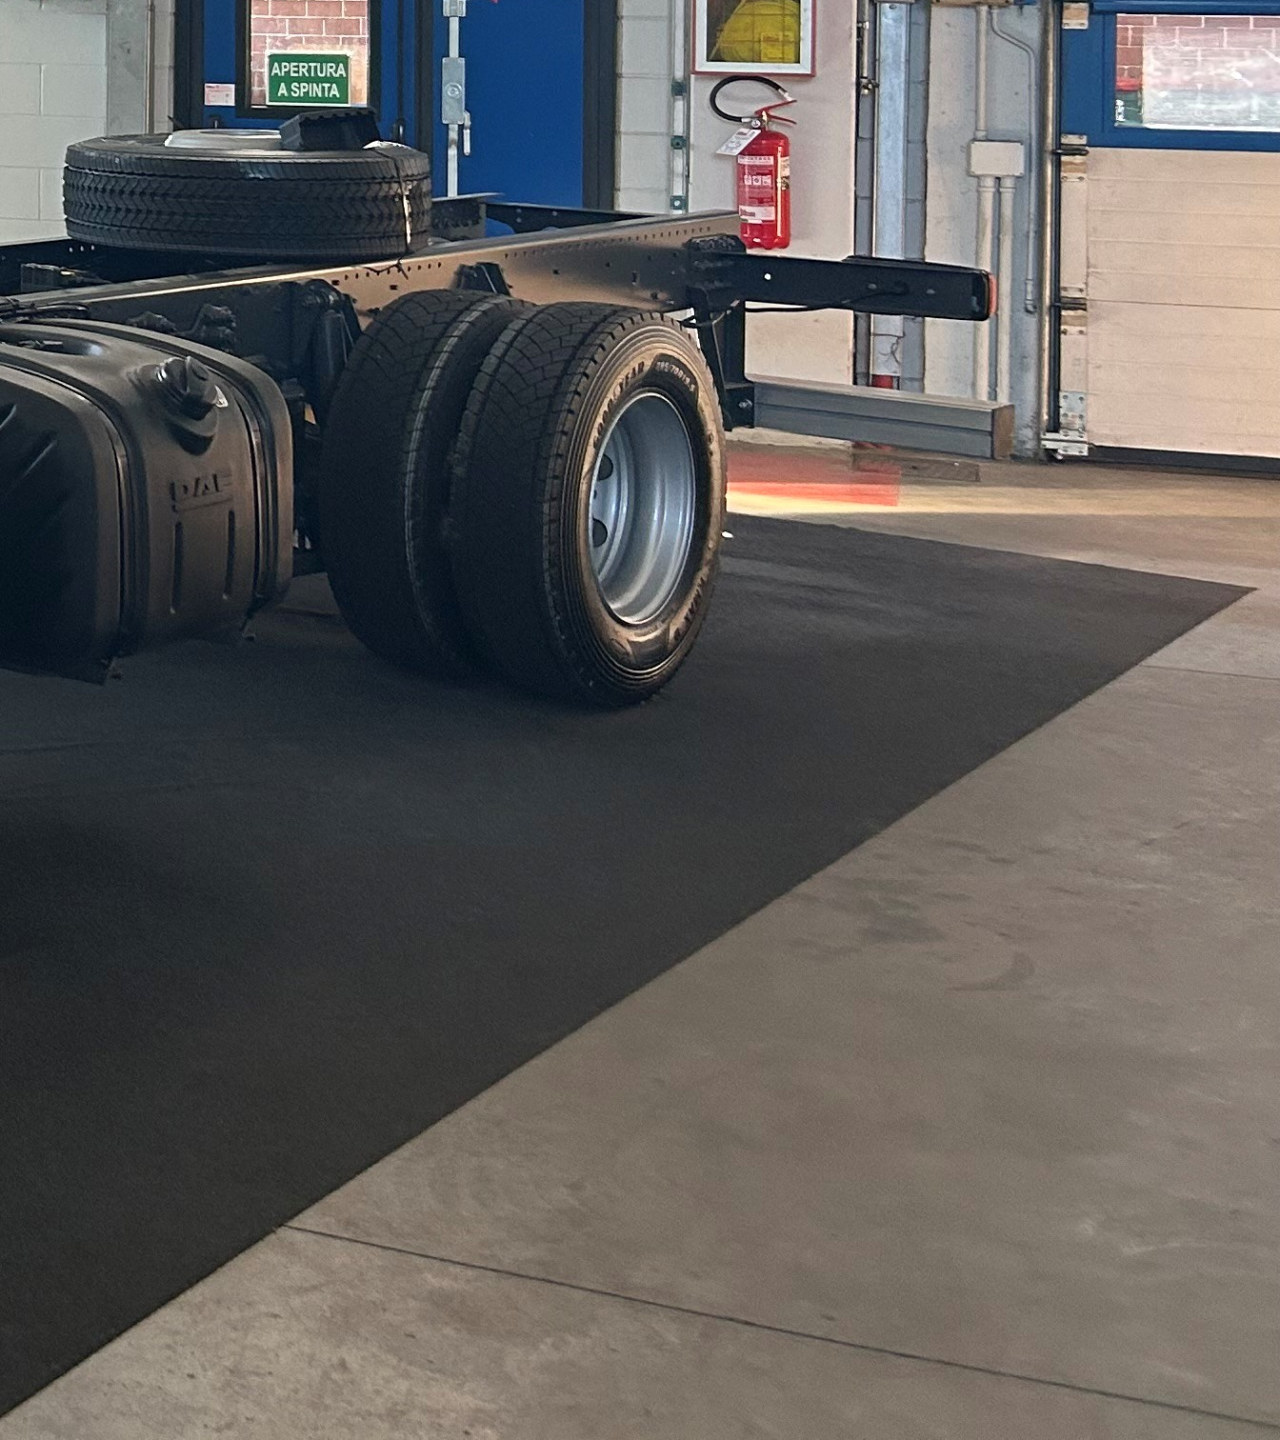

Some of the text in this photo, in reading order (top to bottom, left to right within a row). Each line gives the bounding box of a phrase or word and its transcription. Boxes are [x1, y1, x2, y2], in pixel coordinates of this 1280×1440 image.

[271, 62, 347, 78] APERTURA
[277, 82, 340, 98] A SPINTA
